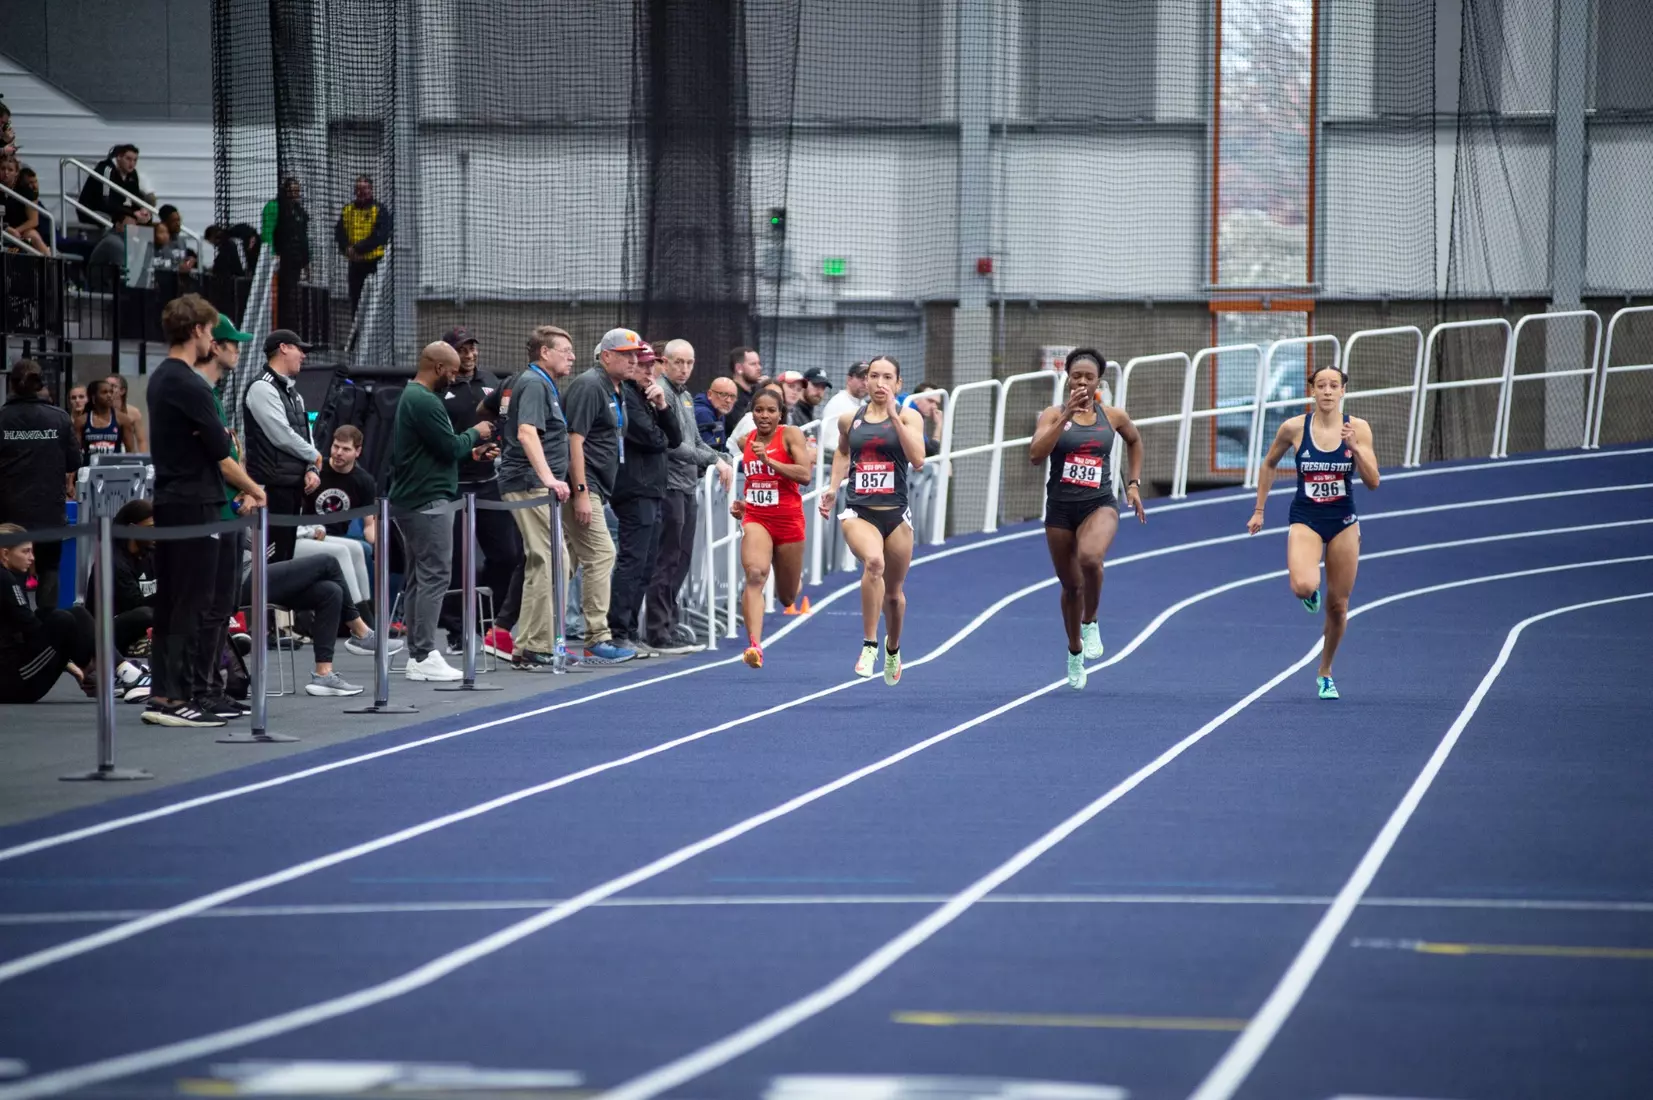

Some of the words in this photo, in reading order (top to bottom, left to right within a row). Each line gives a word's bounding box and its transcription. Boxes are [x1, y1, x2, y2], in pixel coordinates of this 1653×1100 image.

[1069, 464, 1096, 481] 839
[1301, 461, 1330, 473] FRESNO
[1331, 463, 1352, 472] STATE
[861, 473, 888, 488] 857
[1311, 481, 1339, 497] 296
[751, 490, 773, 504] 104
